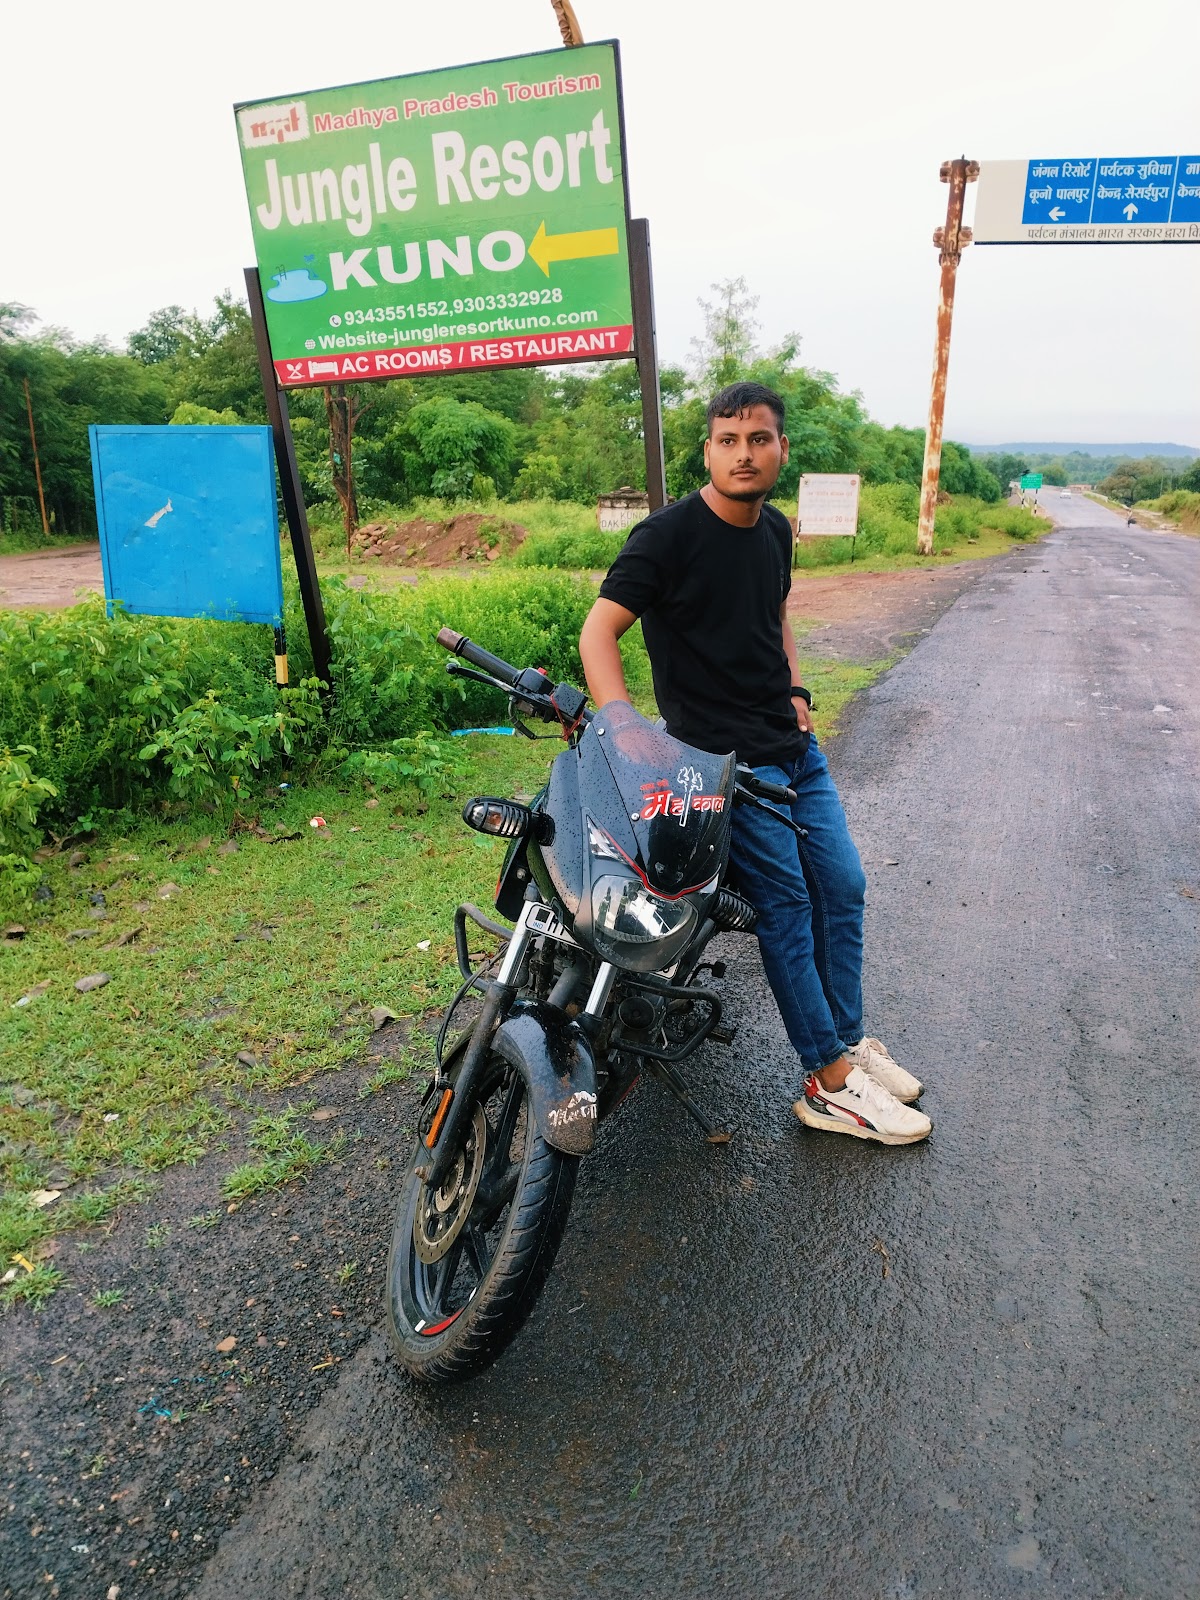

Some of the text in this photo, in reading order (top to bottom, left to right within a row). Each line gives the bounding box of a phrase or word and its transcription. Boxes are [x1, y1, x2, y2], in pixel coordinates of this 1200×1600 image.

[314, 74, 601, 133] Madhya Pradesh Tourism
[256, 108, 613, 237] Jungle Resort
[1032, 161, 1093, 178] जंगल रिसोर्ट
[1100, 160, 1173, 180] पर्यटक सुविधा
[1185, 163, 1200, 176] मा
[1029, 185, 1091, 204] कूनो पालपुर
[1028, 223, 1200, 239] पर्यटन मंत्रालय भारत सरकार द्वारा वि
[329, 231, 525, 290] KUNO
[344, 288, 562, 325] 9343551552,9303332928
[318, 310, 598, 349] Website-jungleresortkuno.com
[342, 356, 369, 374] AC
[375, 349, 452, 371] ROOMS
[470, 331, 619, 362] RESTAURANT
[601, 519, 620, 528] DAK
